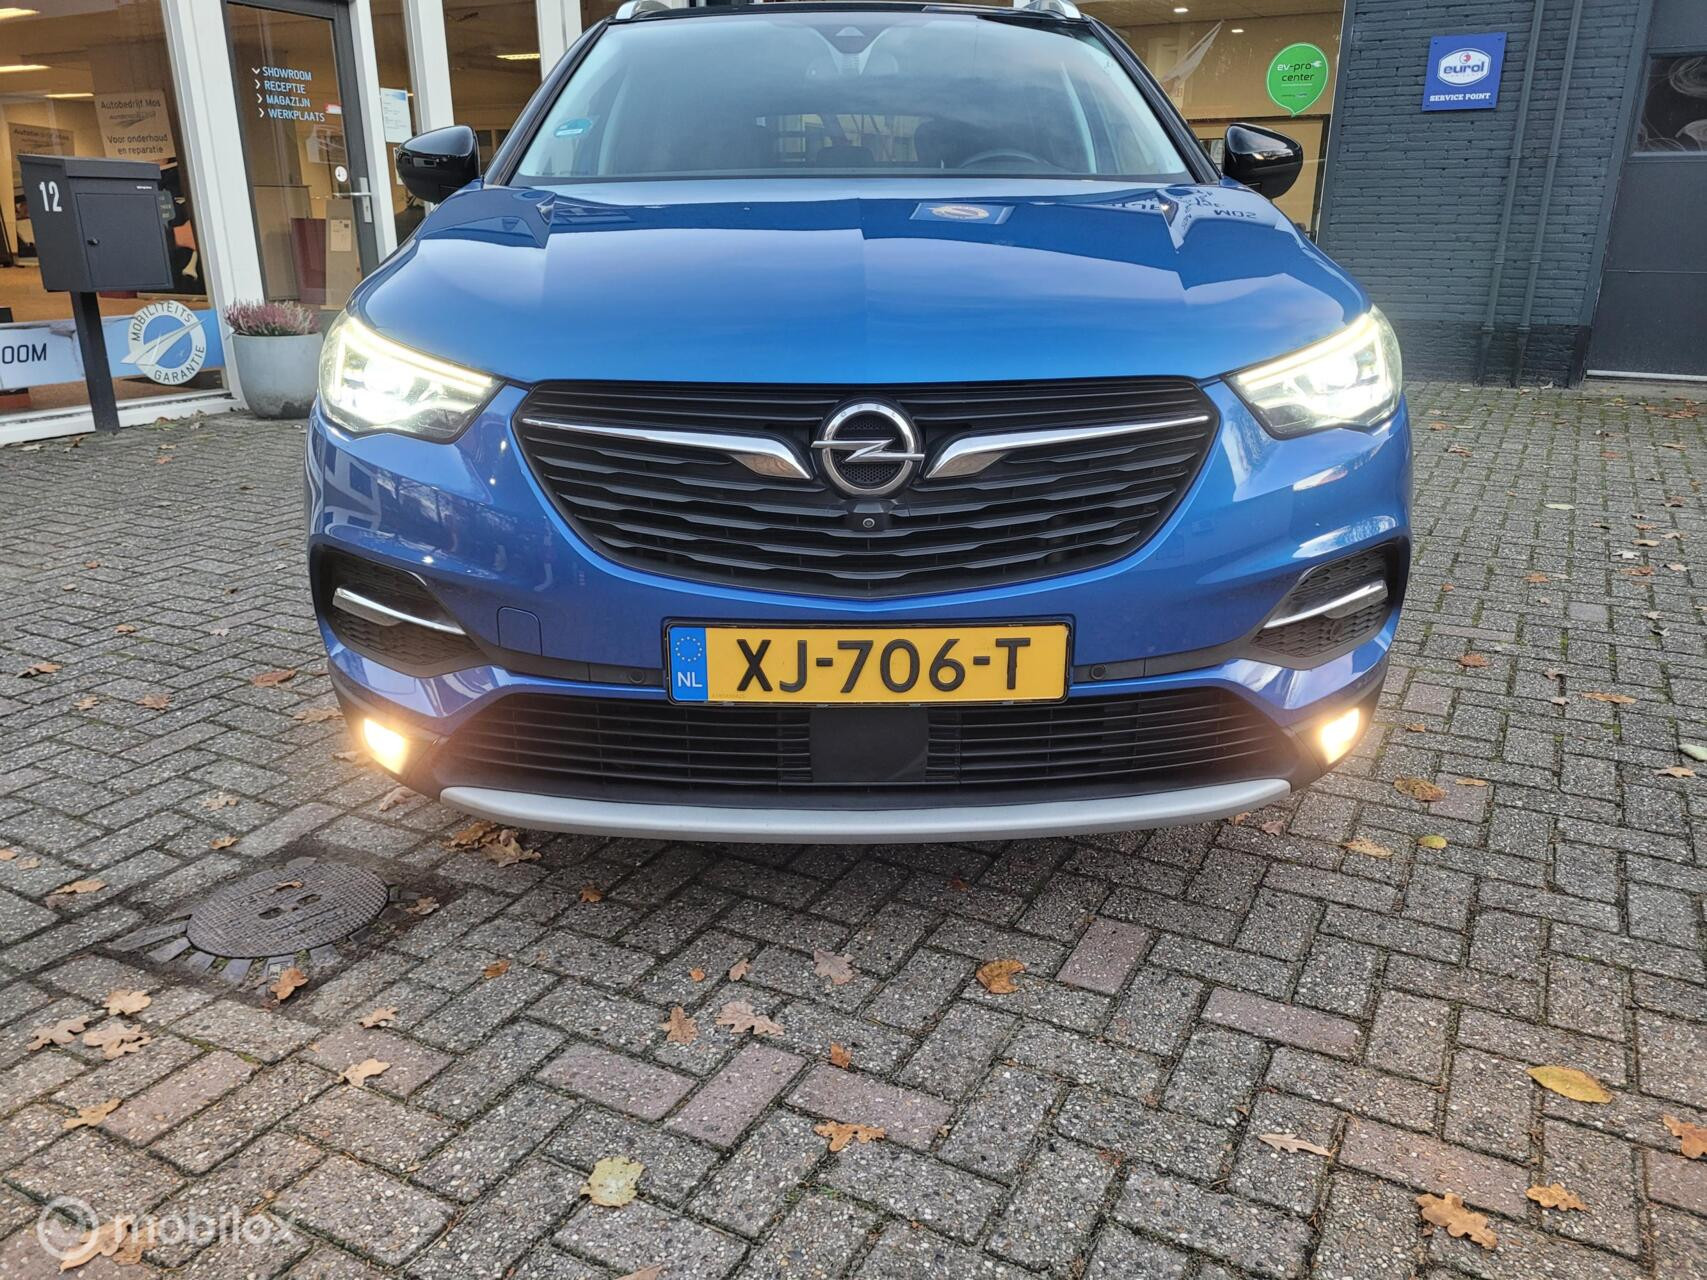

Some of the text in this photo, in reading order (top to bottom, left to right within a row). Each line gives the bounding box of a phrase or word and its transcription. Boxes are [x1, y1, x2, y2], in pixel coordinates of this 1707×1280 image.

[262, 66, 312, 81] SHOWROOM
[1277, 63, 1312, 72] ev-pro
[1443, 61, 1485, 74] eurol
[1281, 74, 1314, 82] center
[264, 80, 306, 94] RECEPTIE
[265, 94, 311, 108] MAGAZIJN
[1429, 92, 1491, 102] SERVICE POINT
[268, 108, 325, 122] WERKPLAATS
[107, 134, 168, 144] Voor onderhoud
[128, 146, 164, 155] reparatie
[39, 181, 63, 212] 12
[131, 300, 193, 342] MOBILITEITS
[154, 345, 205, 383] GARANTIE
[736, 637, 1031, 694] XJ-706-T
[677, 671, 703, 688] NL
